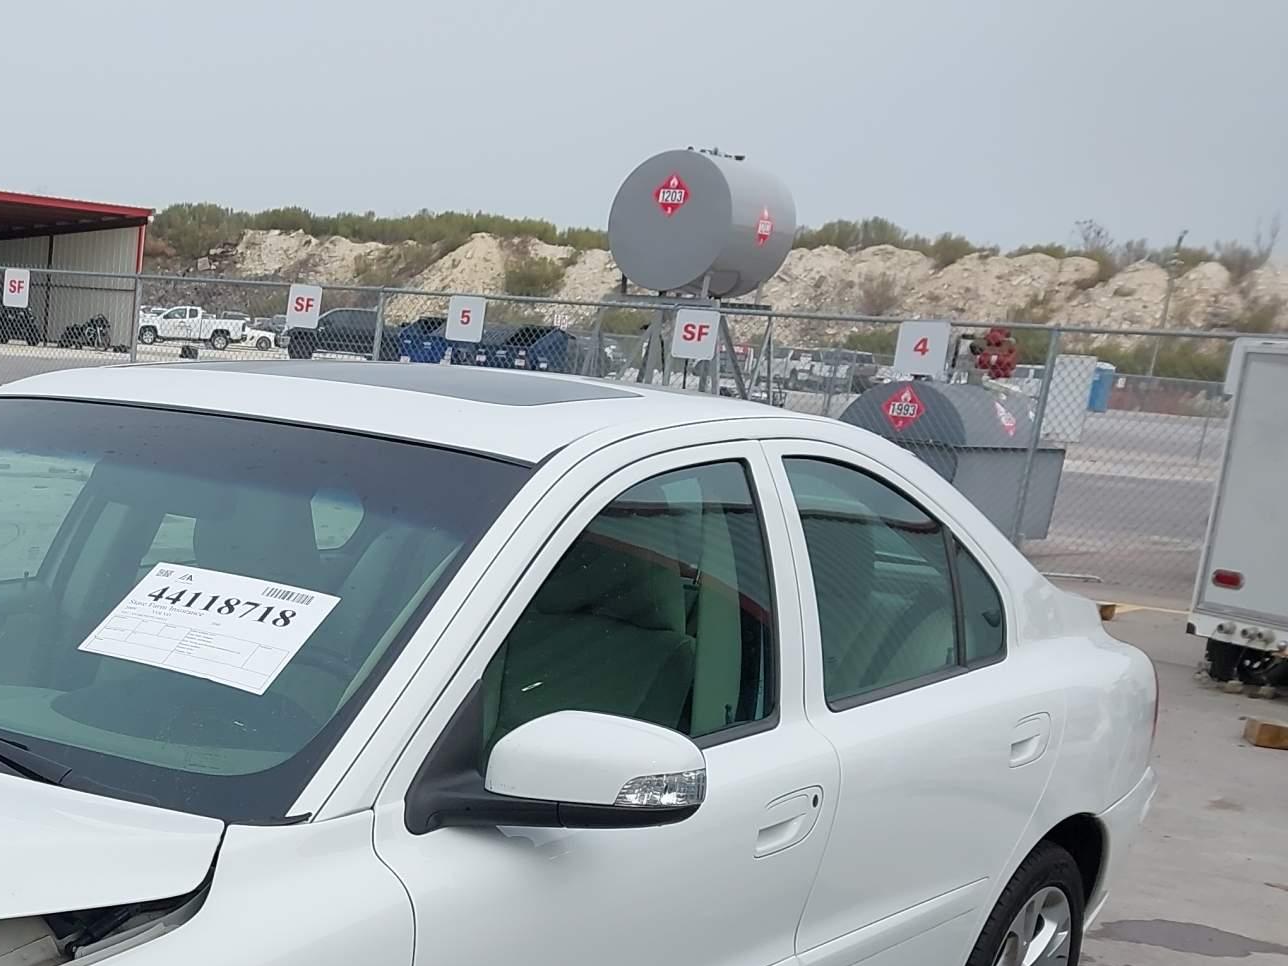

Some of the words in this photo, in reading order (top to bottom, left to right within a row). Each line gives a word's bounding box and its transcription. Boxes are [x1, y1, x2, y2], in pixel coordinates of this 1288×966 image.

[661, 190, 683, 202] 1203
[8, 279, 25, 294] SF
[294, 296, 314, 313] SF
[460, 309, 471, 325] 5
[682, 323, 710, 342] SF
[913, 337, 929, 356] 4
[891, 403, 917, 417] 1993
[147, 586, 297, 628] 44118718
